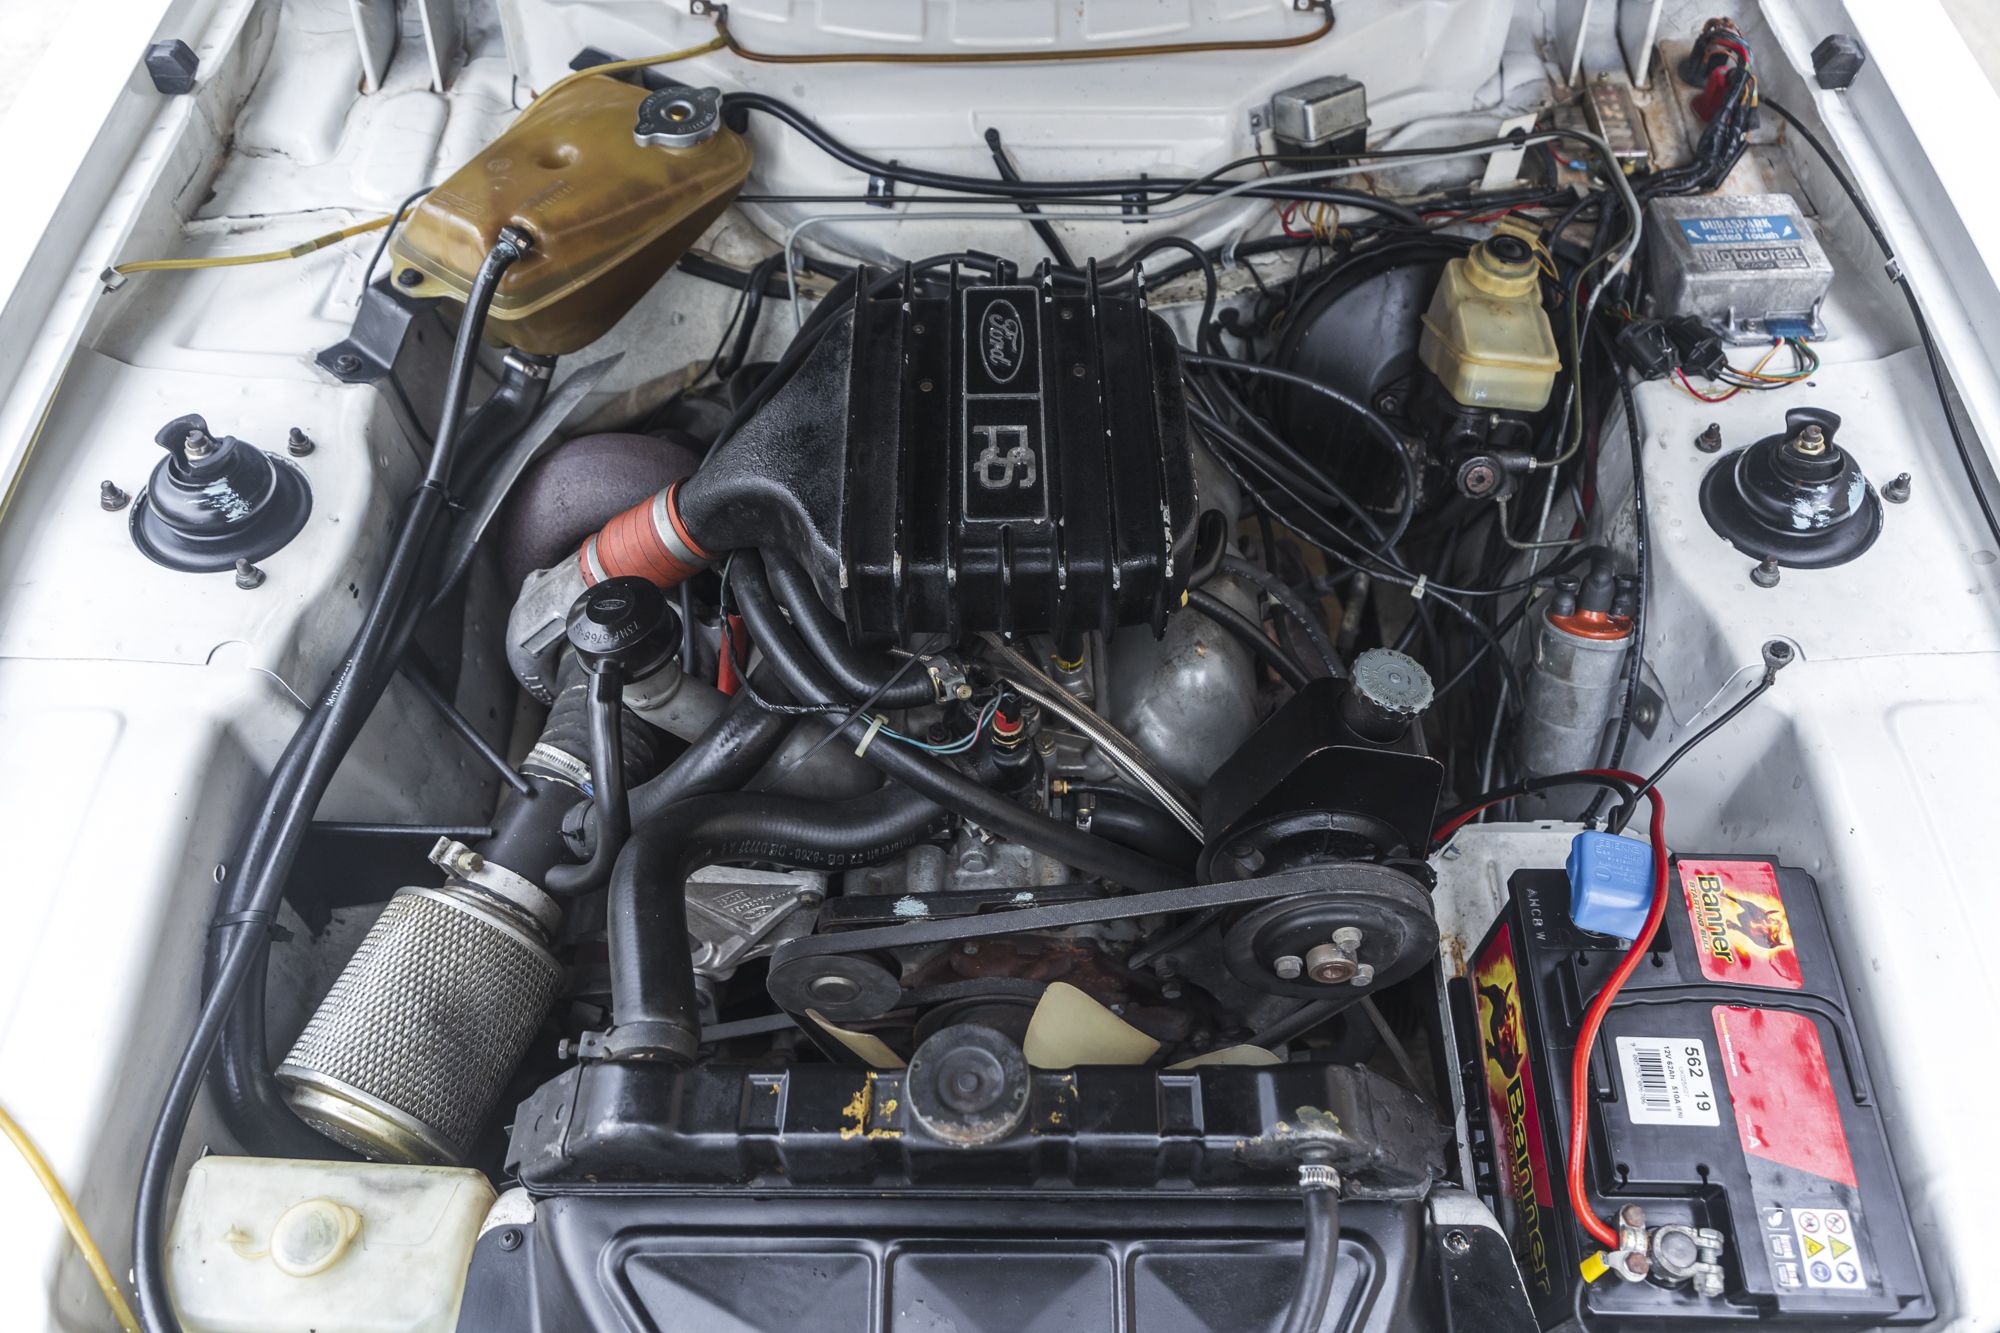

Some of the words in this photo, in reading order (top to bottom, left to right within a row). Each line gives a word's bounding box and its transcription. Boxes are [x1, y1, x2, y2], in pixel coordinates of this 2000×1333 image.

[1700, 218, 1772, 231] DURASPARK
[1705, 232, 1743, 242] tested
[1745, 230, 1780, 240] tough
[1701, 247, 1803, 262] Motorcraft
[988, 313, 1019, 367] Ford
[1689, 881, 1704, 927] STARTING
[1700, 929, 1710, 951] BULL
[1696, 875, 1733, 962] Banner
[1664, 1046, 1672, 1060] 12V
[1666, 1060, 1675, 1080] 62Ah
[1685, 1046, 1704, 1078] 562
[1695, 1091, 1711, 1112] 19
[1671, 1086, 1681, 1104] 510A
[1506, 1073, 1551, 1295] Banner
